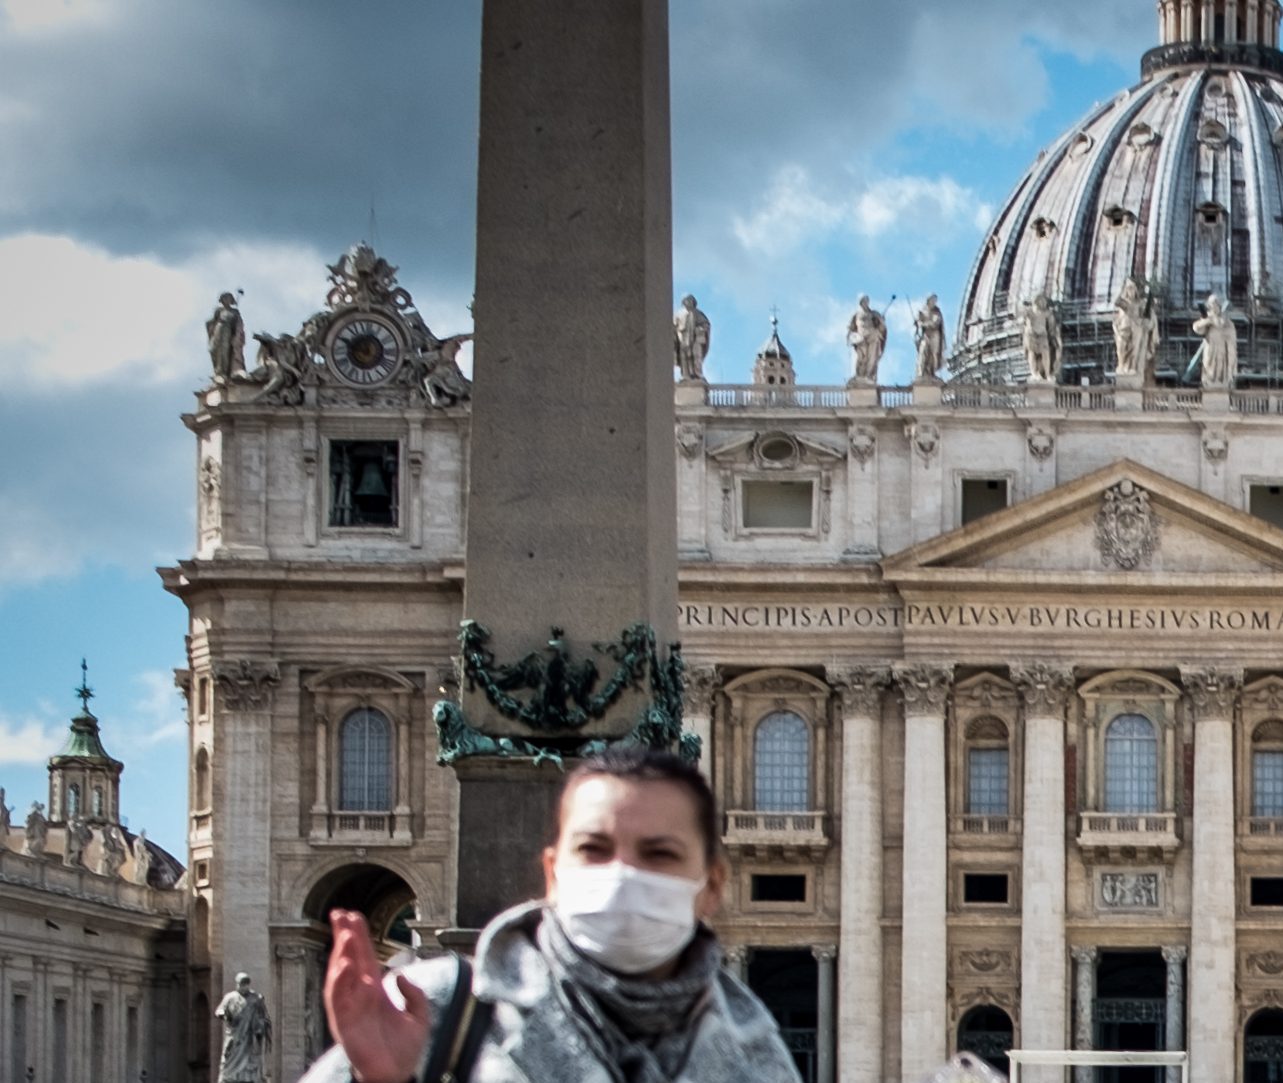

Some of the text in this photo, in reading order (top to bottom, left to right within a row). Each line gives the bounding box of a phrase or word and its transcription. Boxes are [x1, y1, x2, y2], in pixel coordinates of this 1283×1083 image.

[818, 606, 903, 627] APOST
[907, 604, 1000, 625] PAVLVS
[1005, 606, 1021, 625] V
[1028, 606, 1200, 629] BVRGHESIVS
